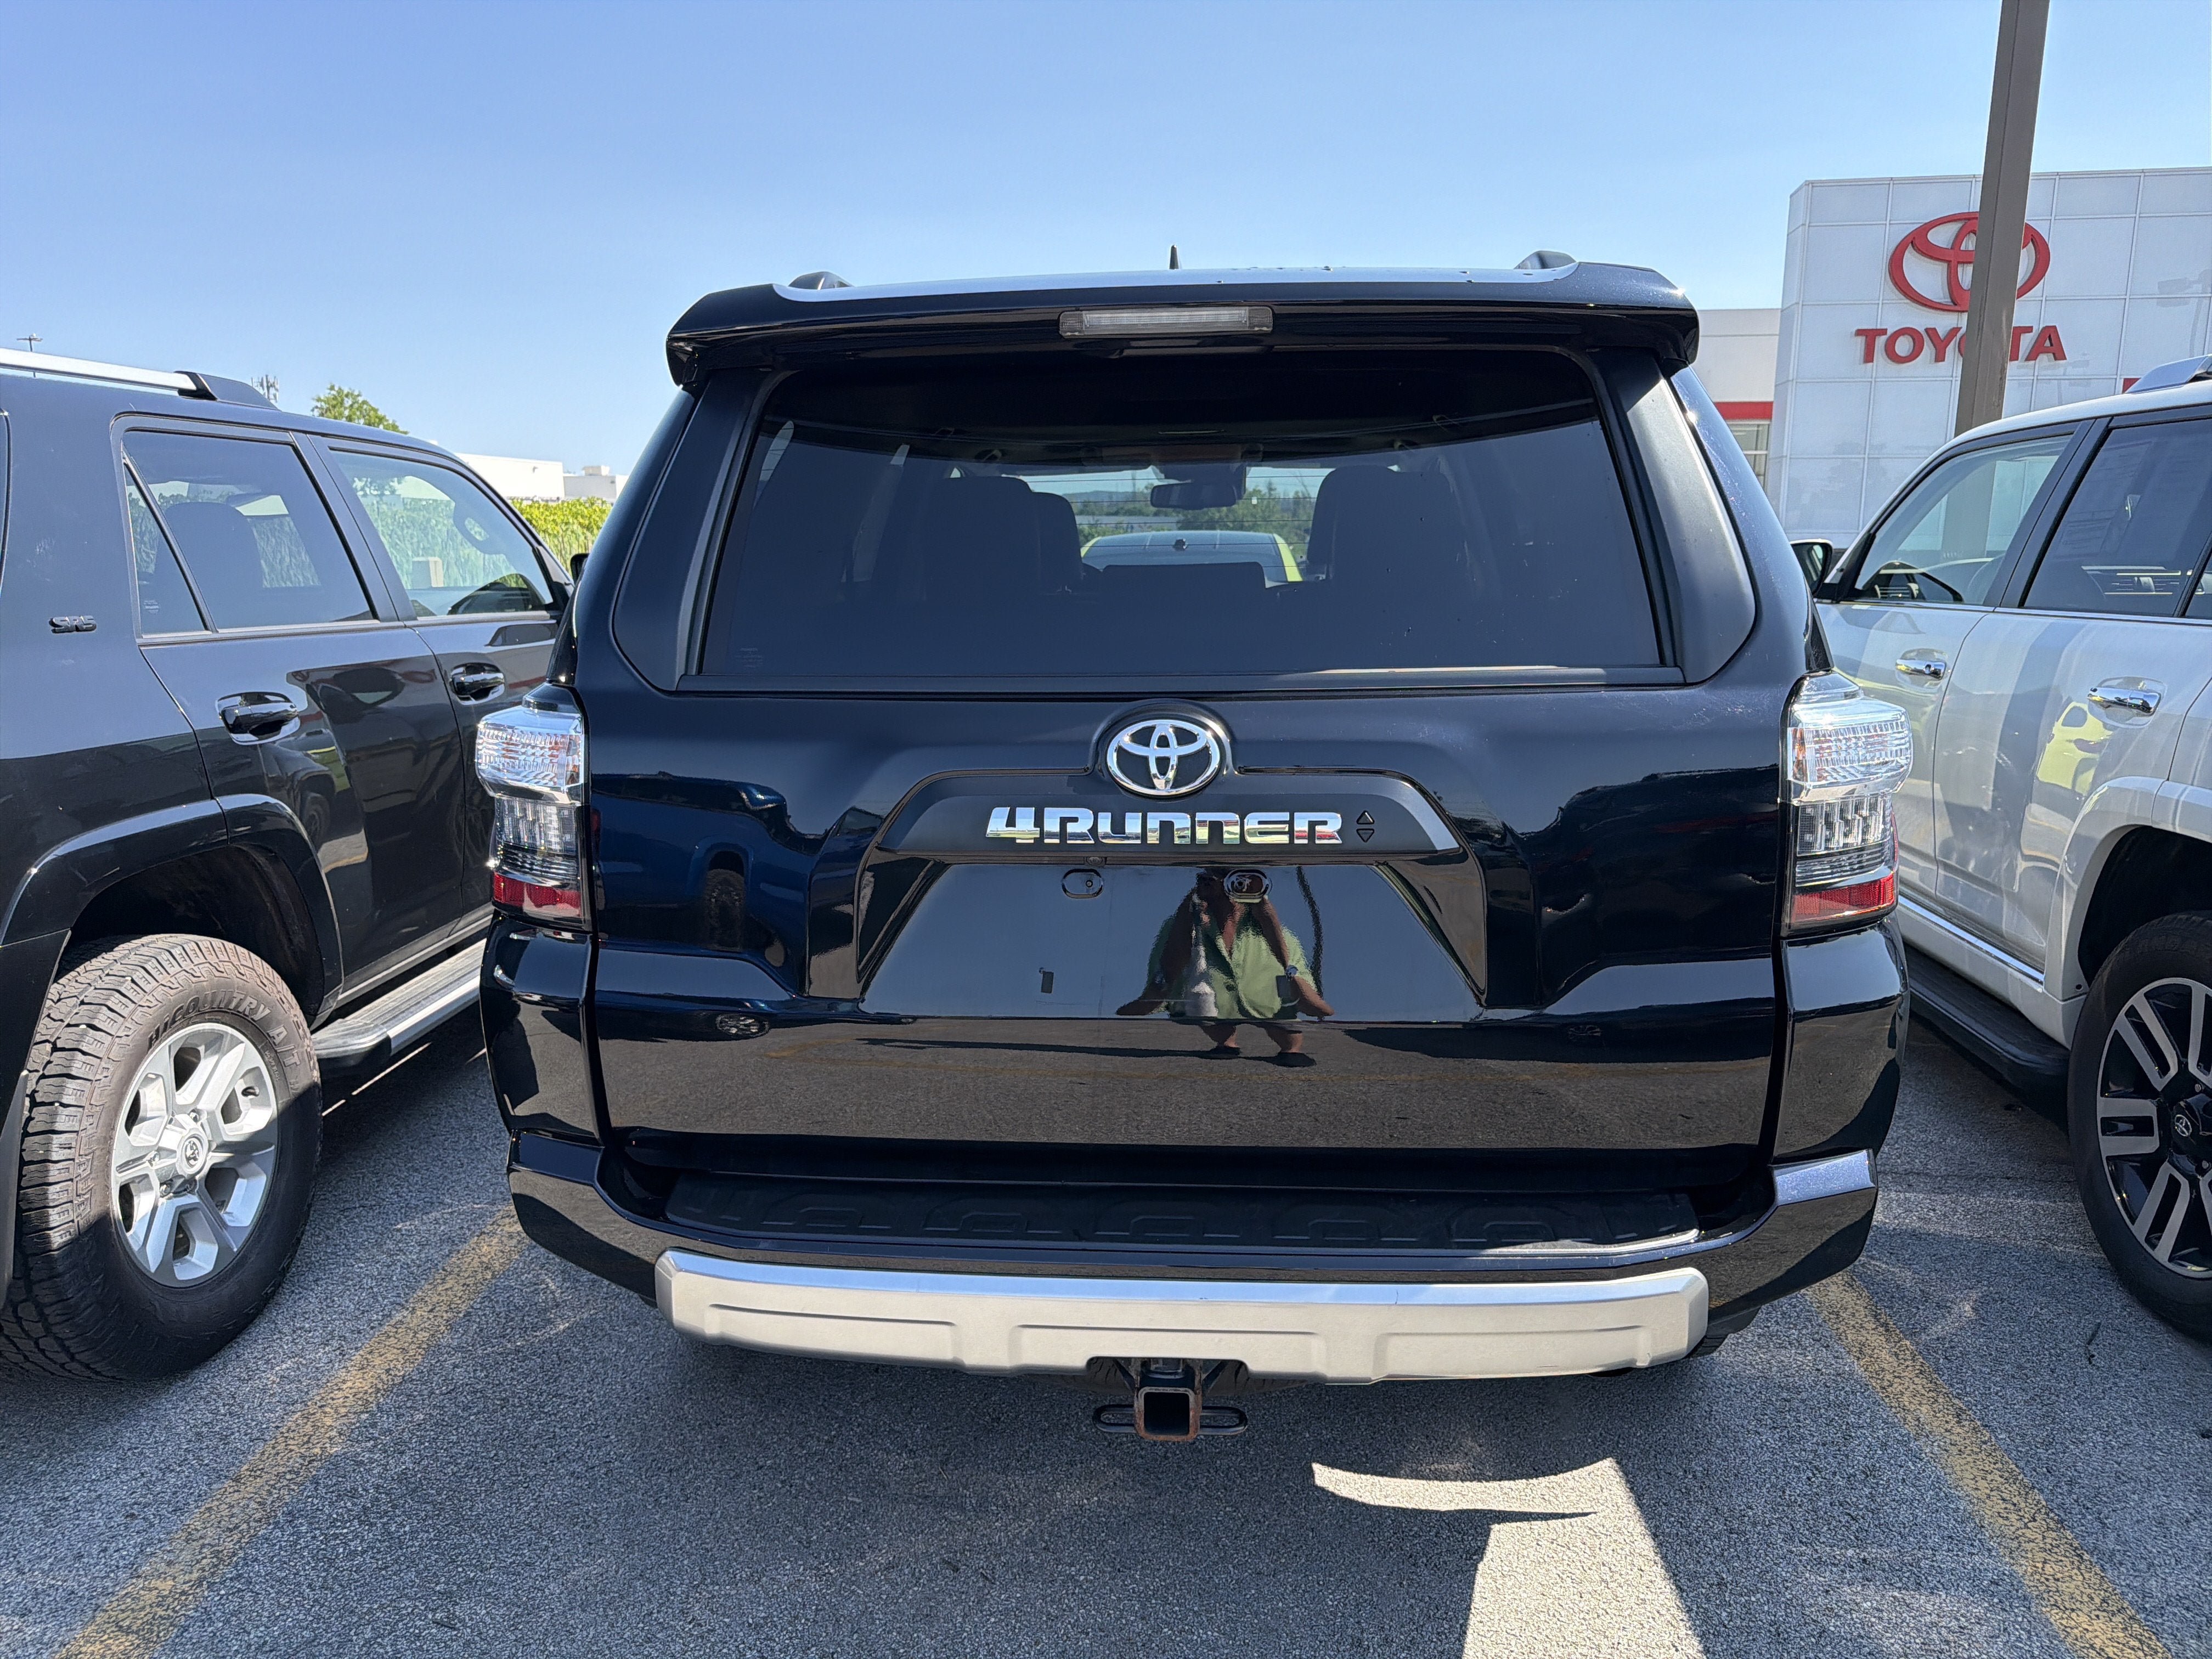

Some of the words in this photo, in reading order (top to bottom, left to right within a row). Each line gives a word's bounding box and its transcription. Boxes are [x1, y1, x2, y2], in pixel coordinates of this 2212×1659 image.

[1855, 325, 2067, 364] TOYTA
[49, 616, 97, 634] SR5
[986, 807, 1343, 844] 4RUNNER
[267, 1024, 301, 1068] A/T
